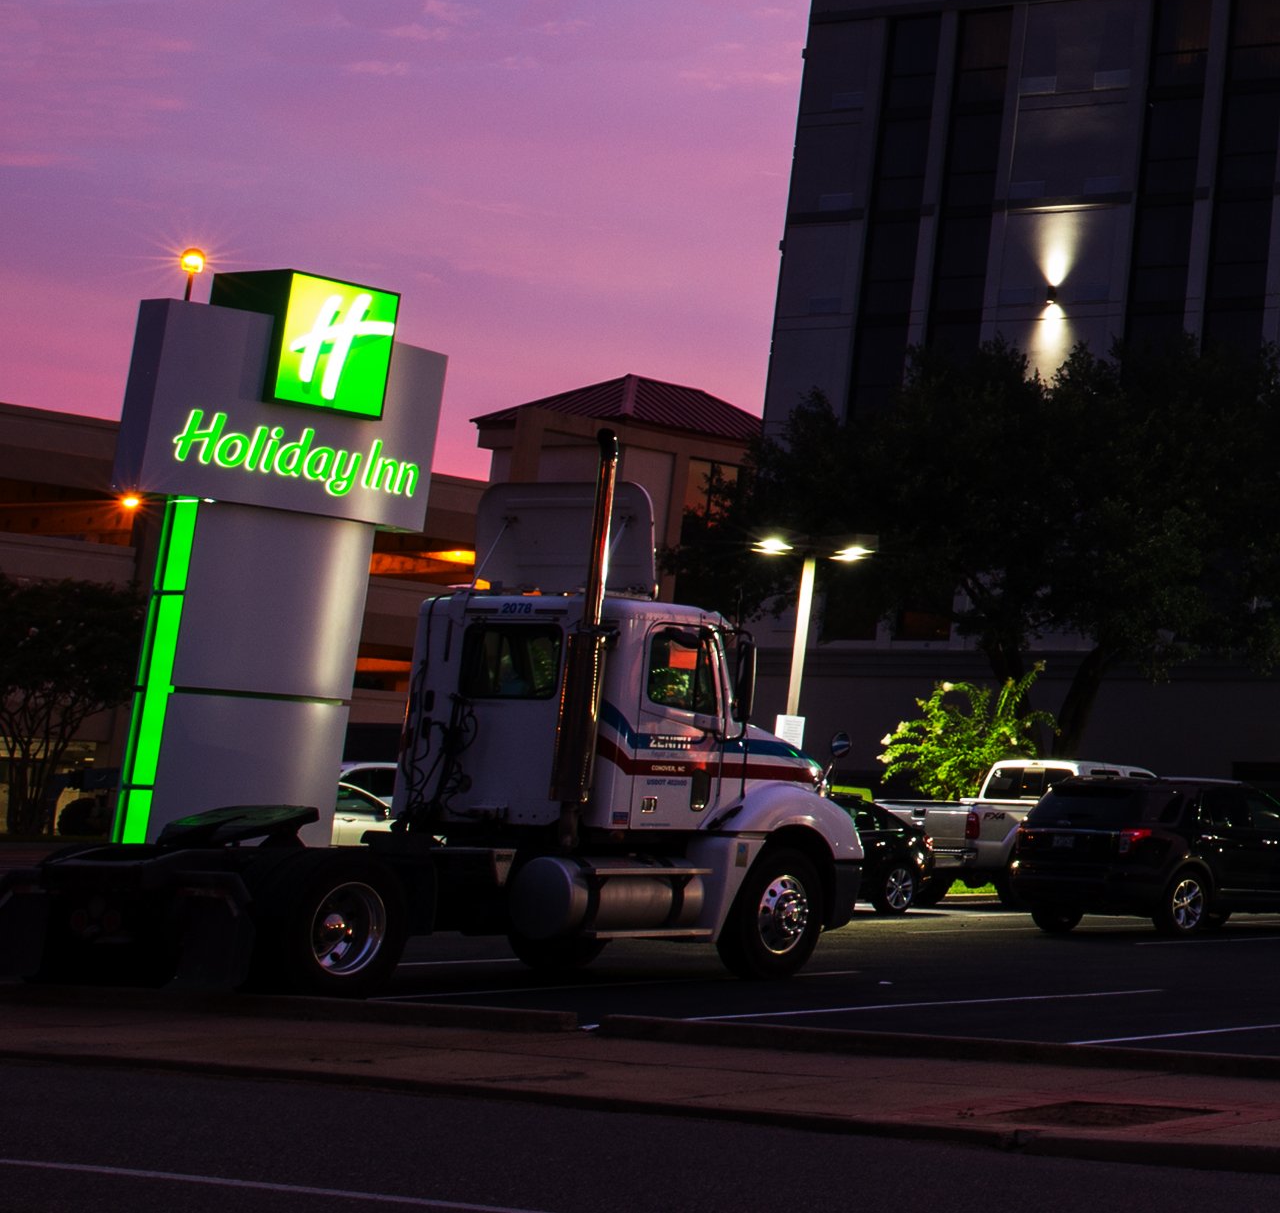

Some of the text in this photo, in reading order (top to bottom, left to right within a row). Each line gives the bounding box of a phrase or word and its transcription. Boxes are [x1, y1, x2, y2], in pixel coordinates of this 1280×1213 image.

[173, 409, 419, 498] Holiday Inn
[502, 602, 533, 614] 2078
[649, 735, 692, 749] ZENITH
[984, 812, 1006, 820] FX4
